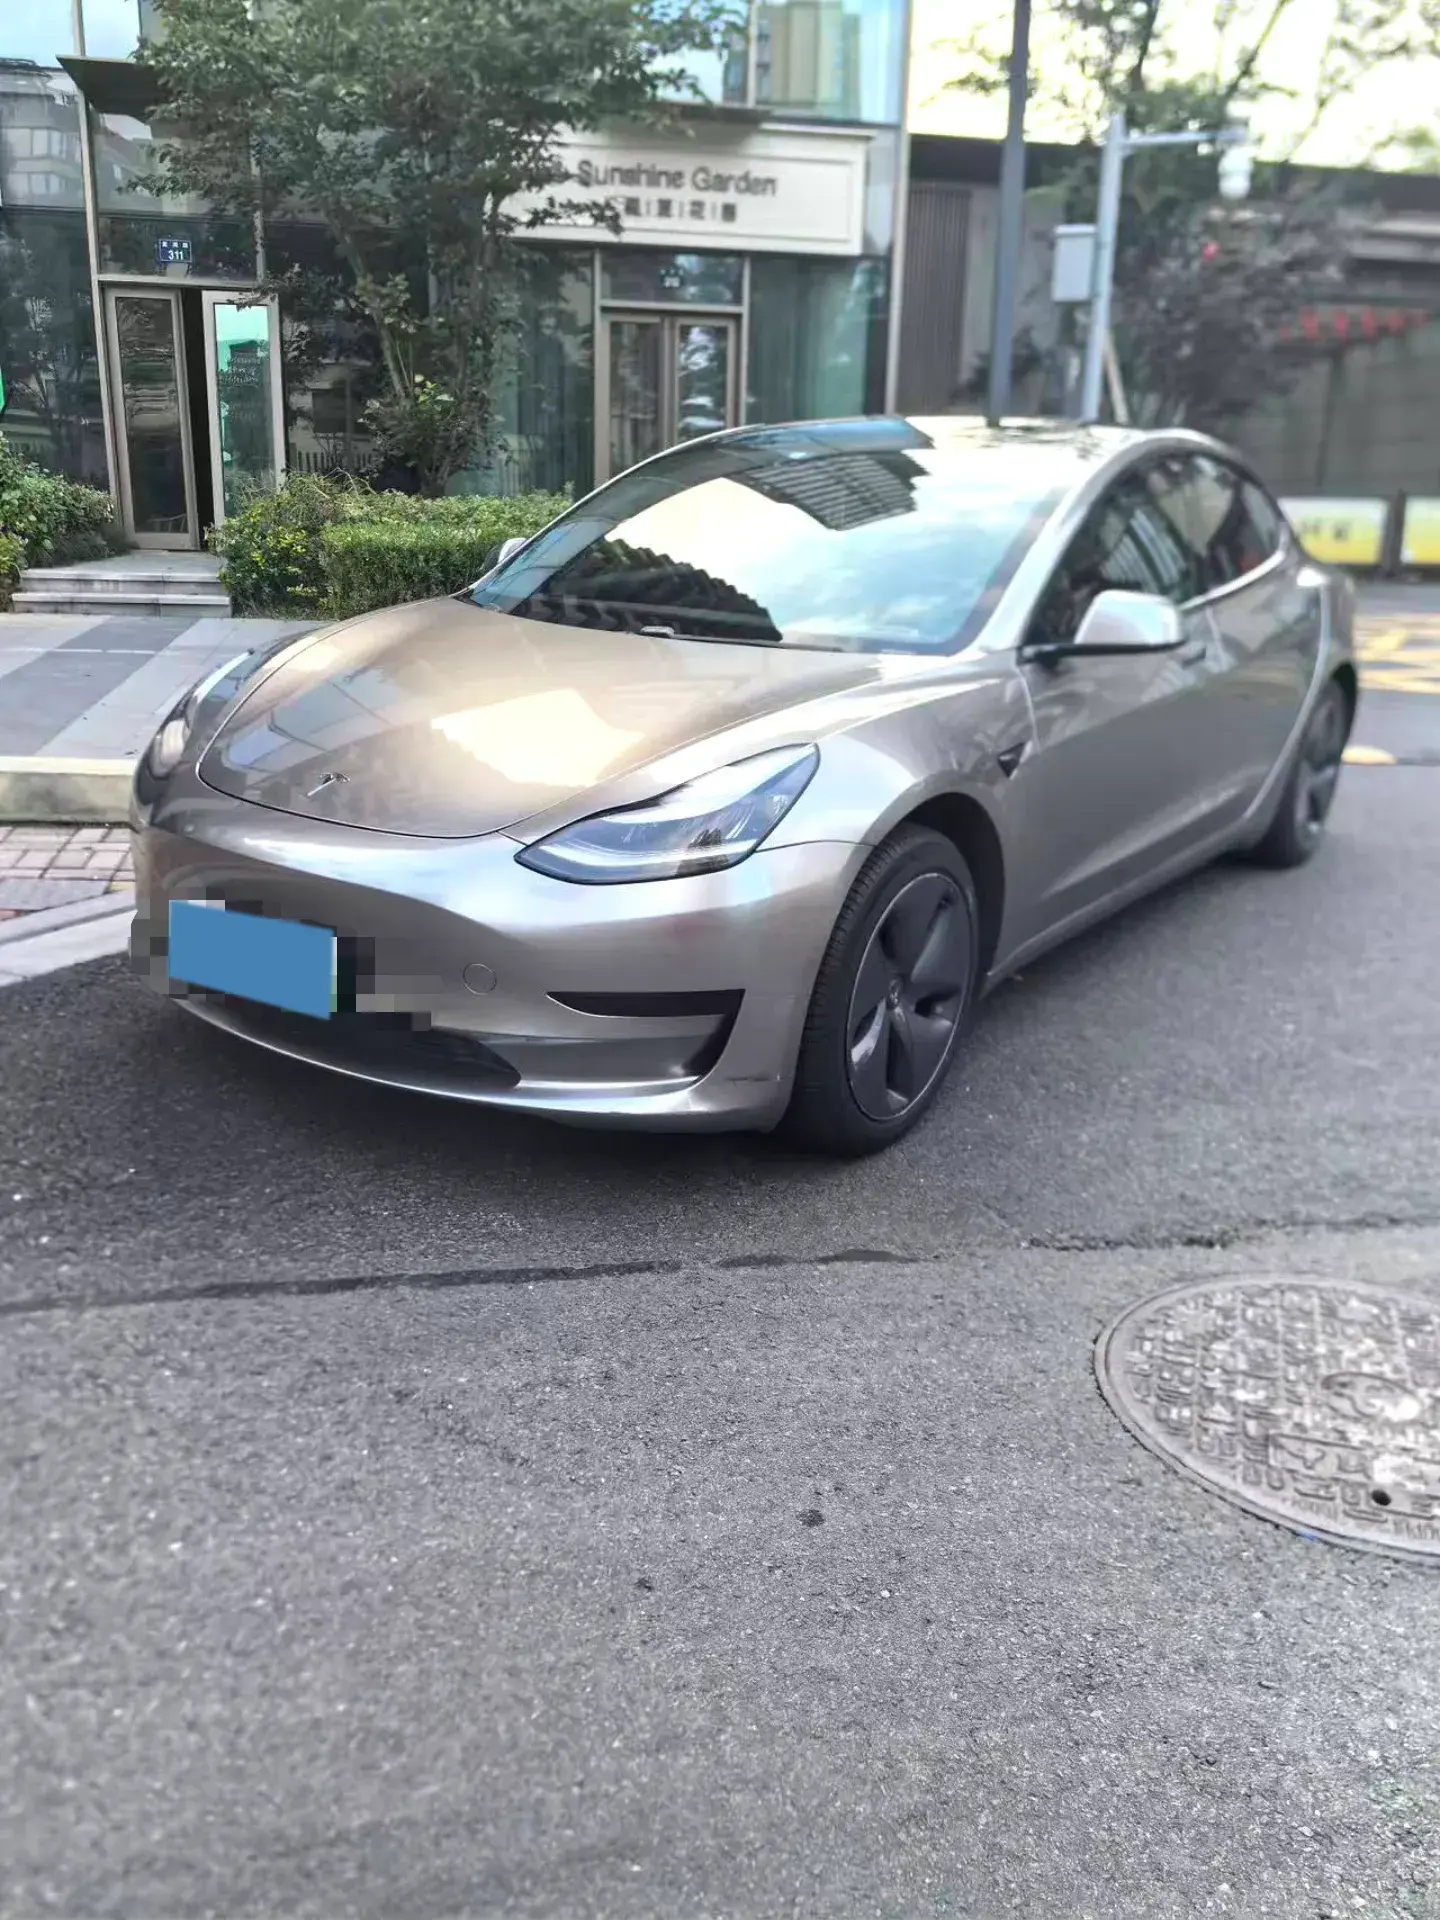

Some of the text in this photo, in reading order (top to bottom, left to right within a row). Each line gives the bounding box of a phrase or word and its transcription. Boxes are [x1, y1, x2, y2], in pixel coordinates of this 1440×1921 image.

[578, 160, 777, 196] Sunshine Garden
[168, 250, 184, 260] 311
